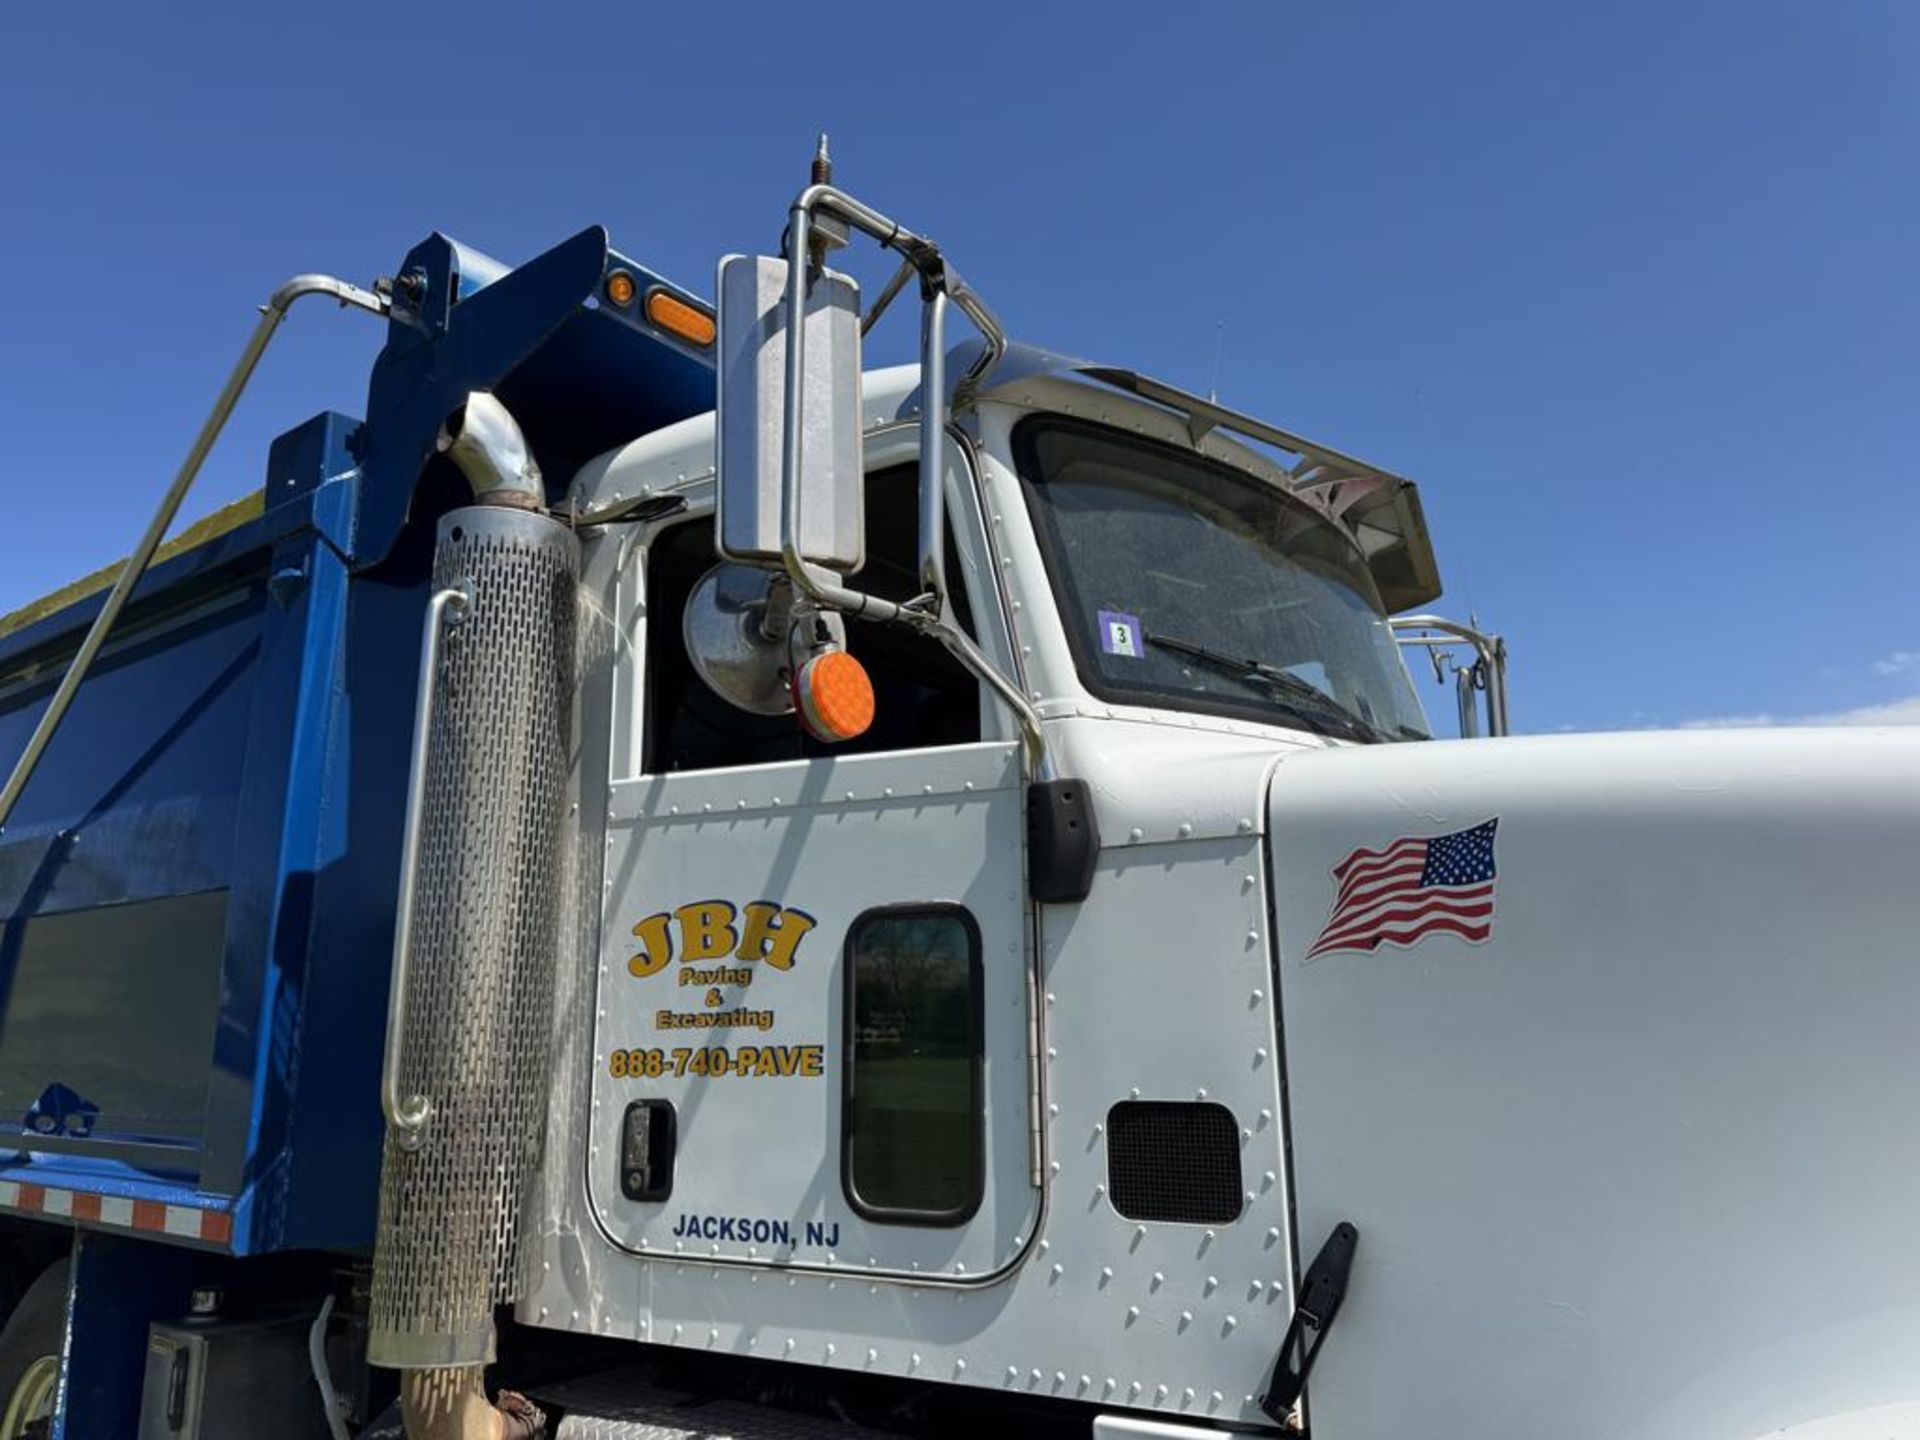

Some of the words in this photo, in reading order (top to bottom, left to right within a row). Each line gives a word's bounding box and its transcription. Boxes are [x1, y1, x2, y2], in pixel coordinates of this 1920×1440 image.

[1116, 626, 1127, 644] 3
[627, 899, 818, 978] JBH
[678, 965, 753, 987] Paving
[704, 987, 723, 1007] &
[655, 1008, 774, 1031] Excavating
[609, 1045, 824, 1079] 888-740-PAVE
[673, 1214, 797, 1251] JACKSON,
[806, 1222, 839, 1247] NJ
